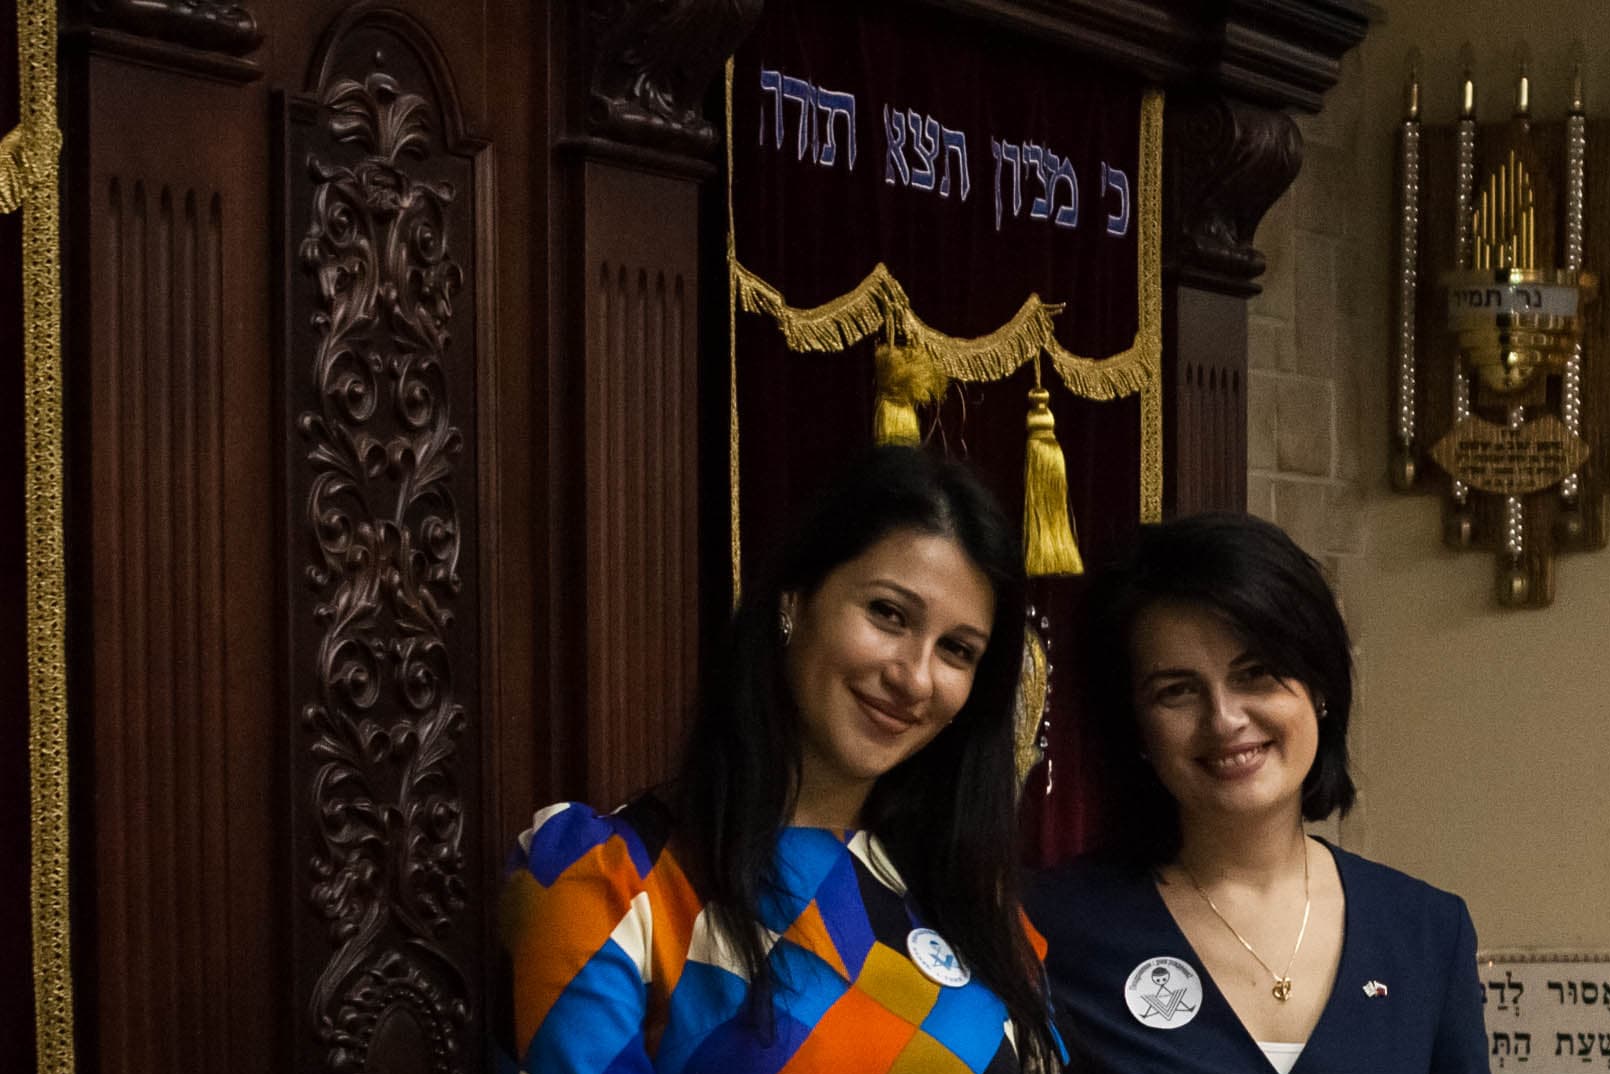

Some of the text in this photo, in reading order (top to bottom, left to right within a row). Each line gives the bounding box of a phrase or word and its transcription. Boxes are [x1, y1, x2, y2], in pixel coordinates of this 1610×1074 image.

[760, 69, 1130, 235] כי מציון תצא תורה
[1516, 289, 1542, 308] נר
